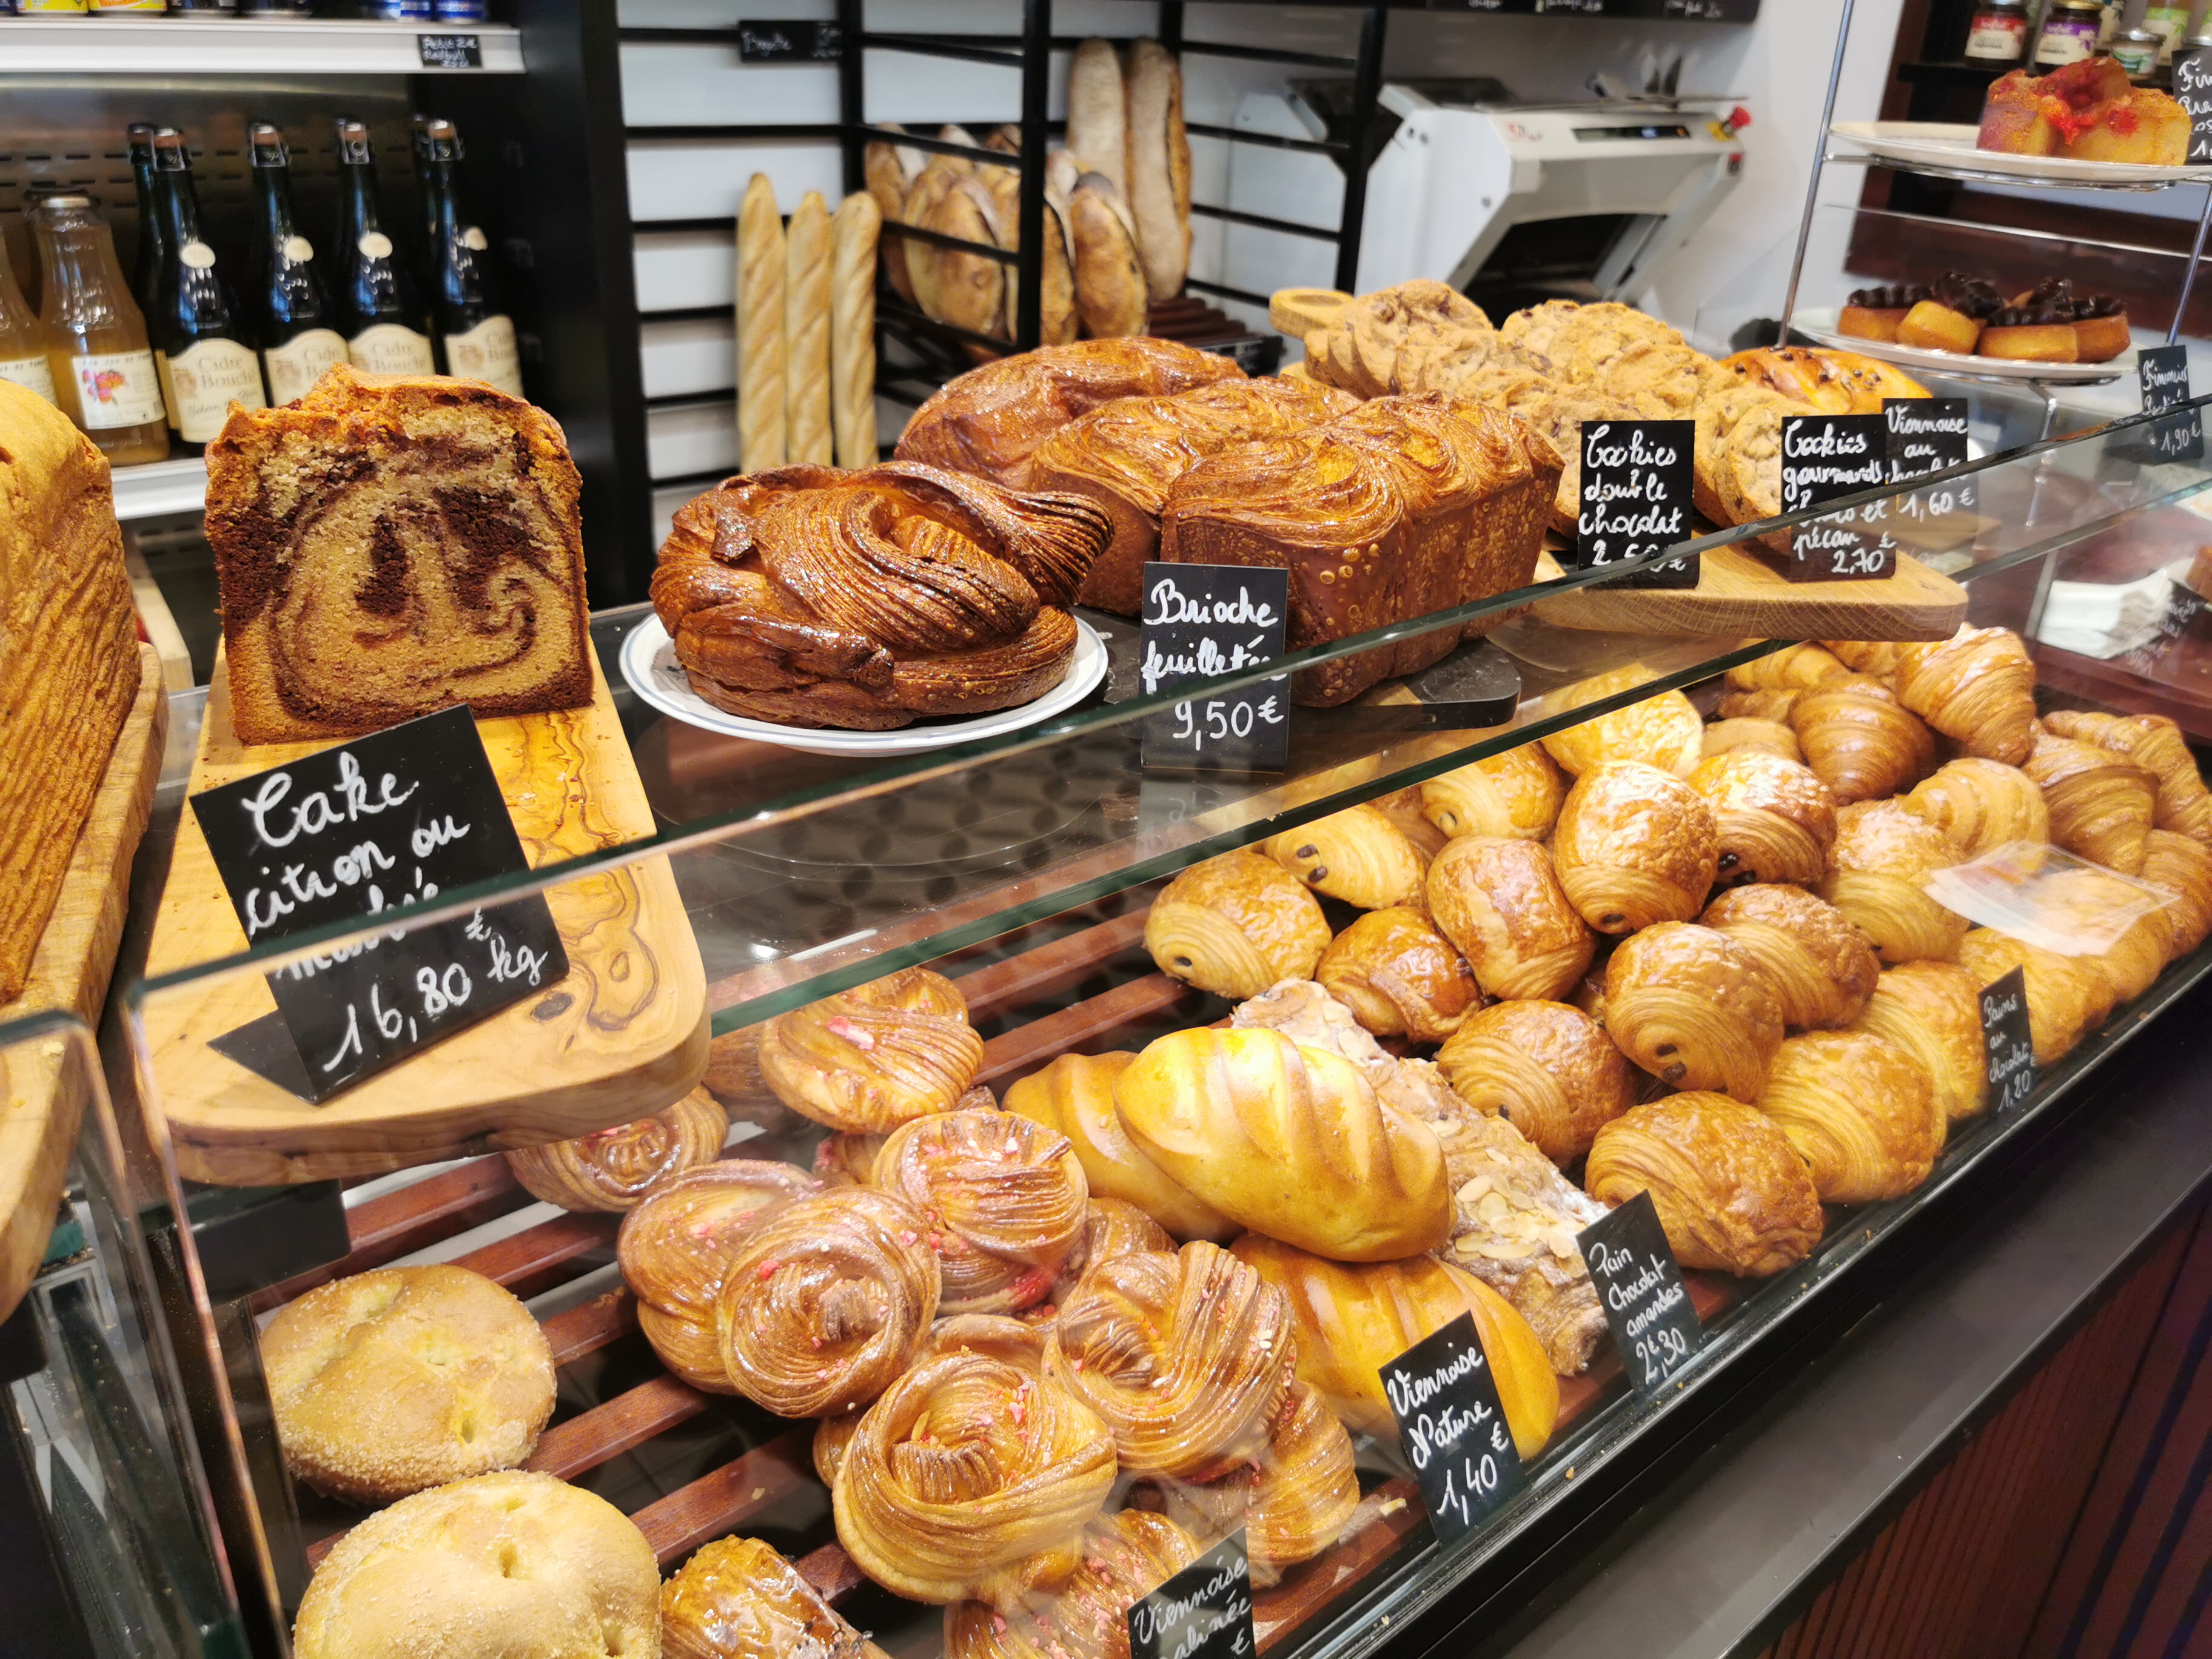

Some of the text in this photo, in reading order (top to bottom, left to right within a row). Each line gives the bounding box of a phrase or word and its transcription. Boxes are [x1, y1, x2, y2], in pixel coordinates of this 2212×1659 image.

[198, 354, 244, 374] Cidre
[1587, 424, 1677, 468] Cookies
[1784, 418, 1868, 458] Cookies
[1904, 443, 1938, 458] au
[1143, 578, 1279, 628] Brioche
[241, 751, 420, 848] Cake
[246, 814, 471, 940] citron ou
[1588, 1241, 1634, 1278] Pain
[1386, 1342, 1484, 1416] Viennoise
[1134, 1555, 1248, 1645] Viennoise
